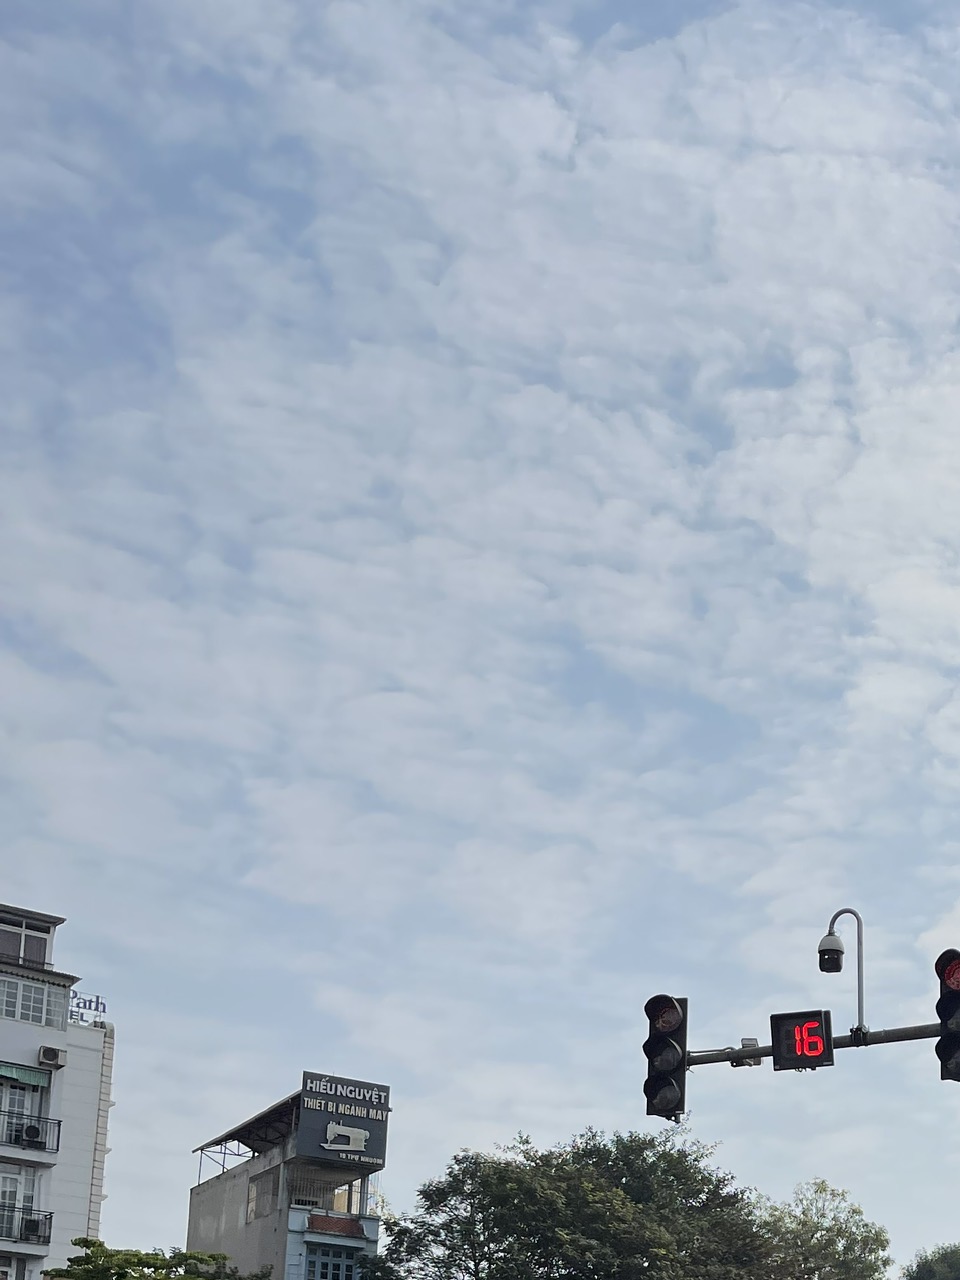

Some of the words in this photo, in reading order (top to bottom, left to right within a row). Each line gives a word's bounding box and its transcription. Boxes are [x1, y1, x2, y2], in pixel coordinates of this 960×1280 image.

[795, 1021, 824, 1057] 16
[307, 1077, 336, 1095] HIẾU
[337, 1085, 387, 1105] NGUYỆT
[304, 1097, 326, 1111] THIẾT
[328, 1102, 336, 1115] BỊ
[338, 1103, 367, 1118] NGÀNH
[369, 1109, 389, 1121] MAY
